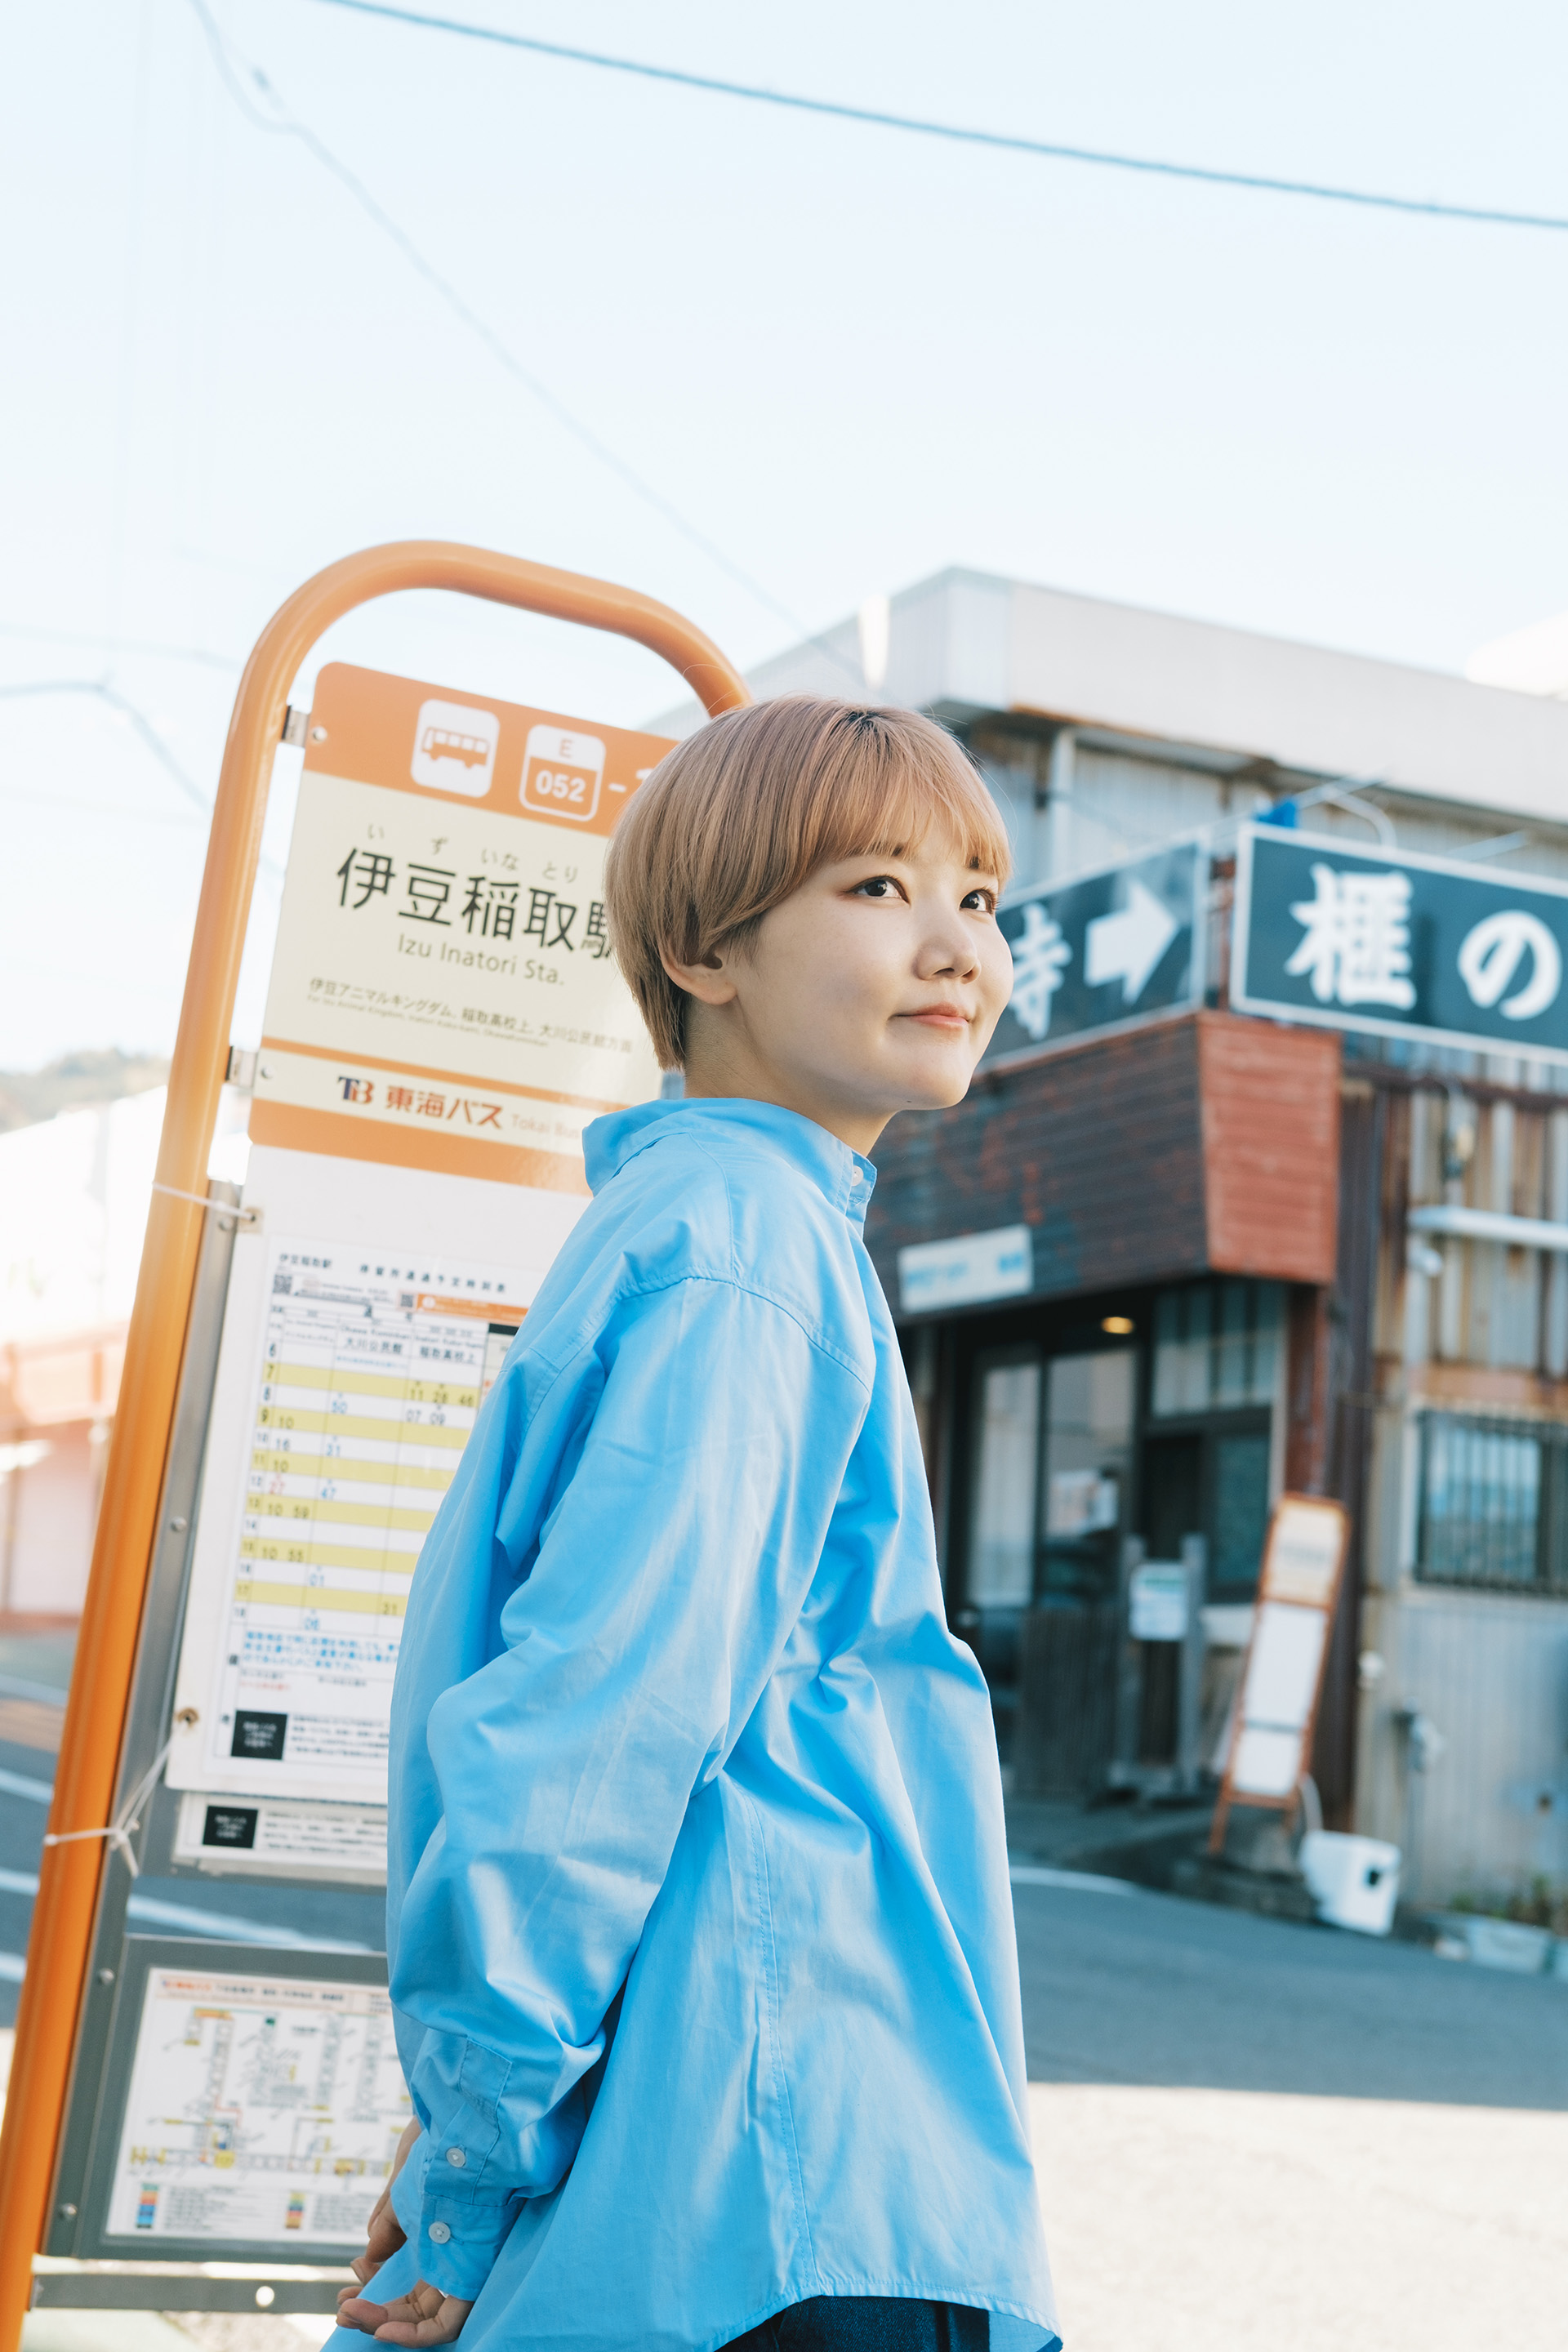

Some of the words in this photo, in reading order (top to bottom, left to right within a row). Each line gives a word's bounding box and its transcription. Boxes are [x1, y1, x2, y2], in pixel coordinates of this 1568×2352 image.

[559, 737, 574, 759] E
[535, 769, 586, 804] 052
[367, 823, 385, 840] い
[430, 836, 450, 857] ず
[398, 933, 432, 958] Izu
[439, 942, 517, 976] Inatori
[523, 959, 565, 986] Sta.
[384, 1084, 503, 1129] 東海バス
[510, 1113, 550, 1134] Tokai
[267, 1363, 274, 1379] 7
[279, 1415, 295, 1429] 10
